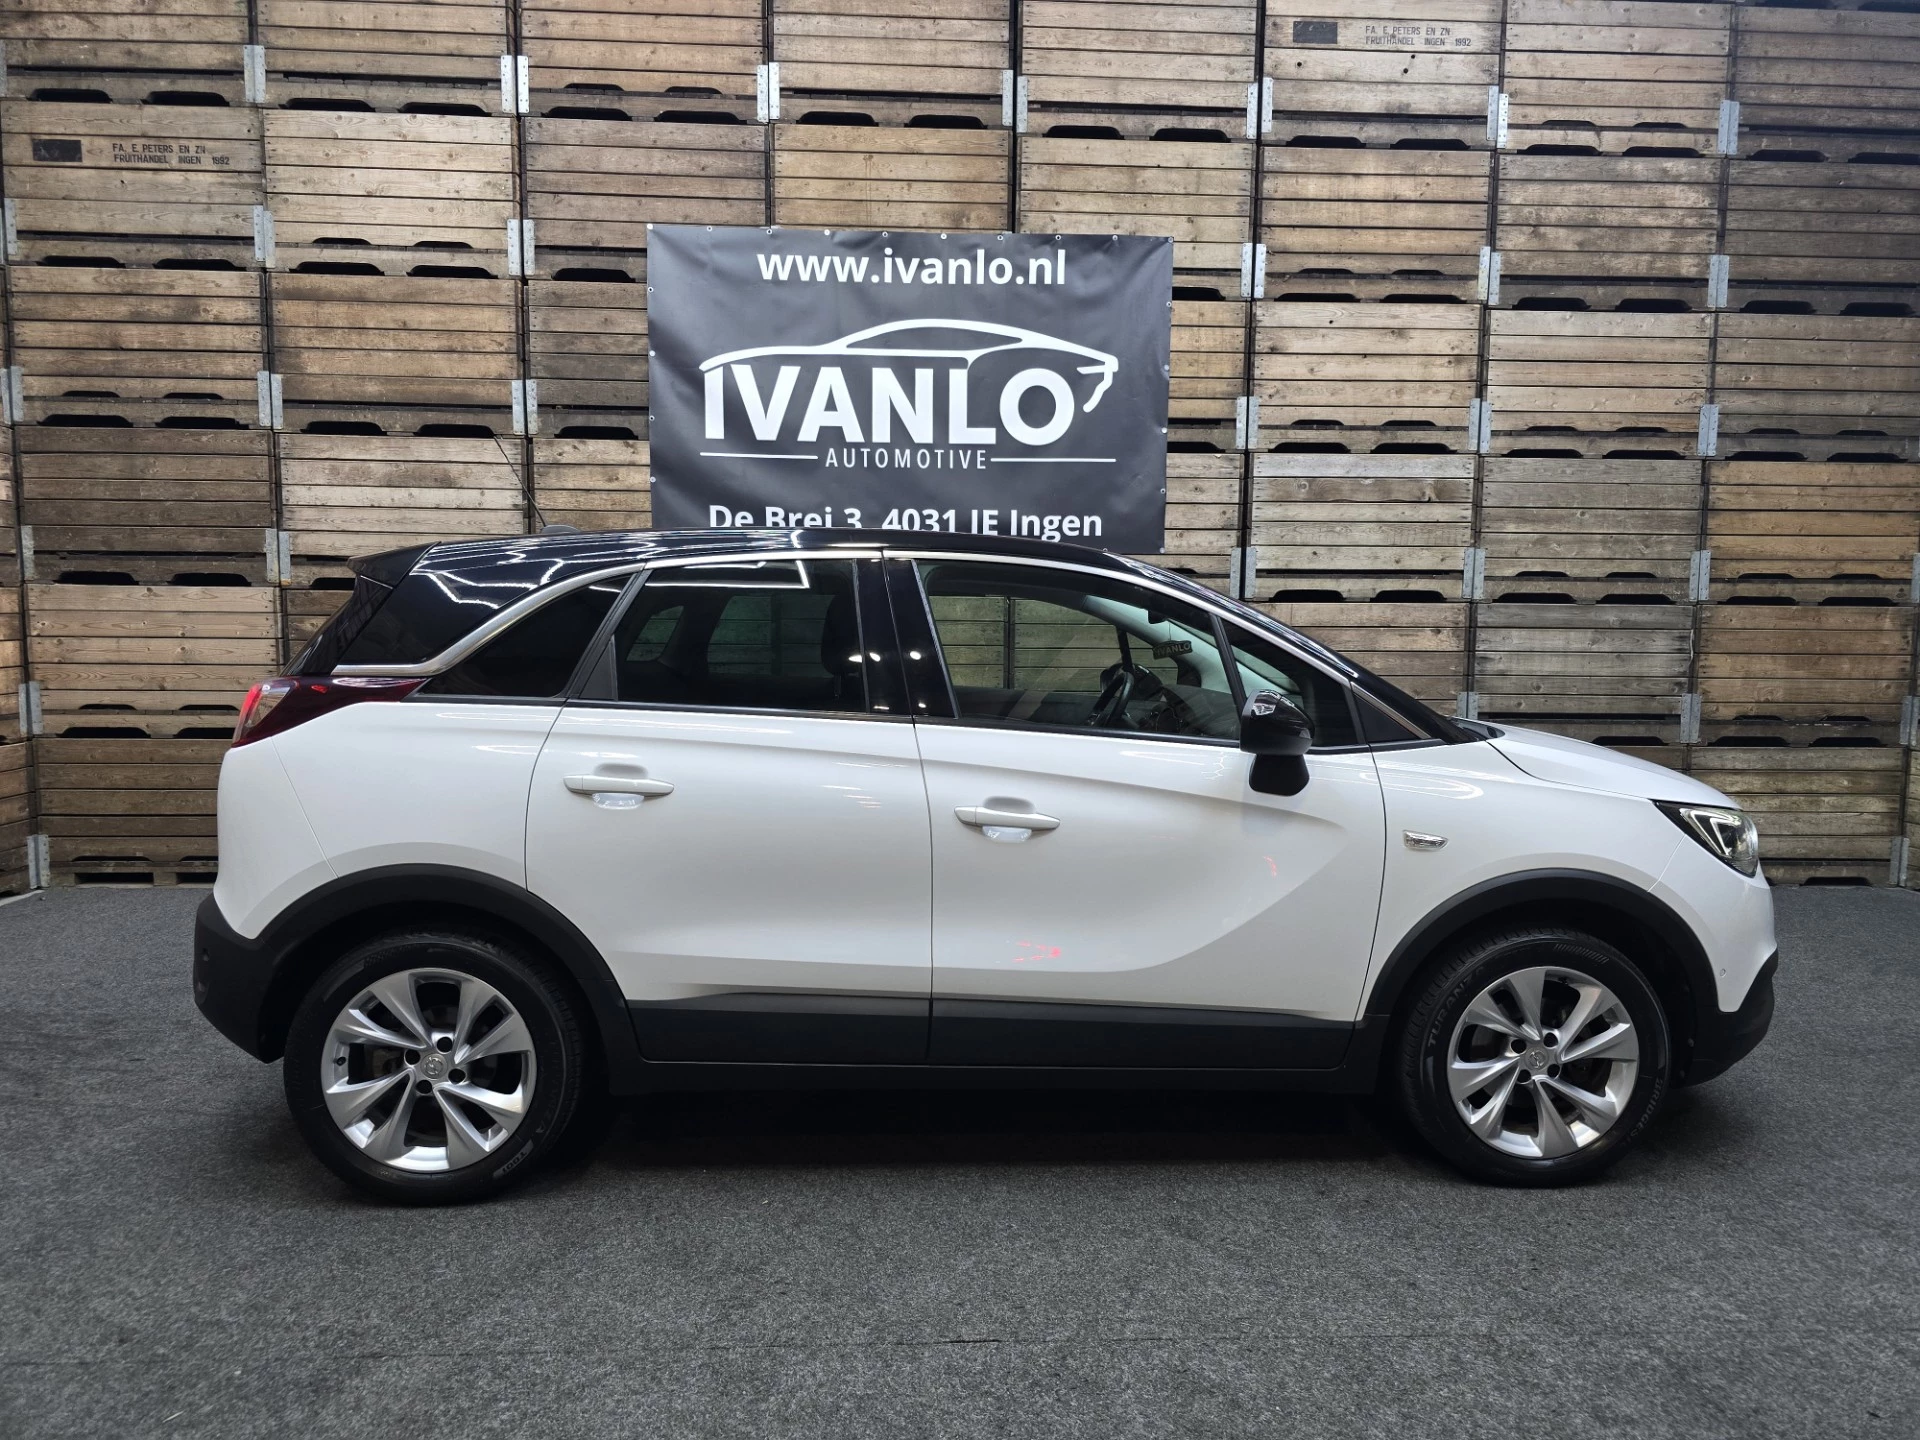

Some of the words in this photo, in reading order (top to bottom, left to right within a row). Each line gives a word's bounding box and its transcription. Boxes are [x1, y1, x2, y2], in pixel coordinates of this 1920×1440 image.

[1392, 26, 1420, 36] PETERS
[1426, 27, 1436, 36] EN
[1440, 28, 1450, 36] ZN
[1365, 36, 1415, 46] FRUITHANDEL
[1424, 37, 1446, 46] INGEN
[1455, 38, 1472, 46] 1992
[142, 144, 174, 154] PETERS
[179, 145, 190, 154] EN
[114, 154, 169, 164] FRUITHANDEL
[178, 155, 202, 164] INGEN
[212, 156, 230, 165] 1992
[756, 247, 1067, 286] www.ivanlo.nl
[704, 363, 1076, 446] IVANLO
[824, 447, 988, 471] AUTOMOTIVE
[709, 504, 754, 528] De
[765, 506, 832, 528] Brei
[880, 508, 956, 533] 4031
[1010, 509, 1102, 543] Ingen
[1157, 642, 1191, 656] IVANLO
